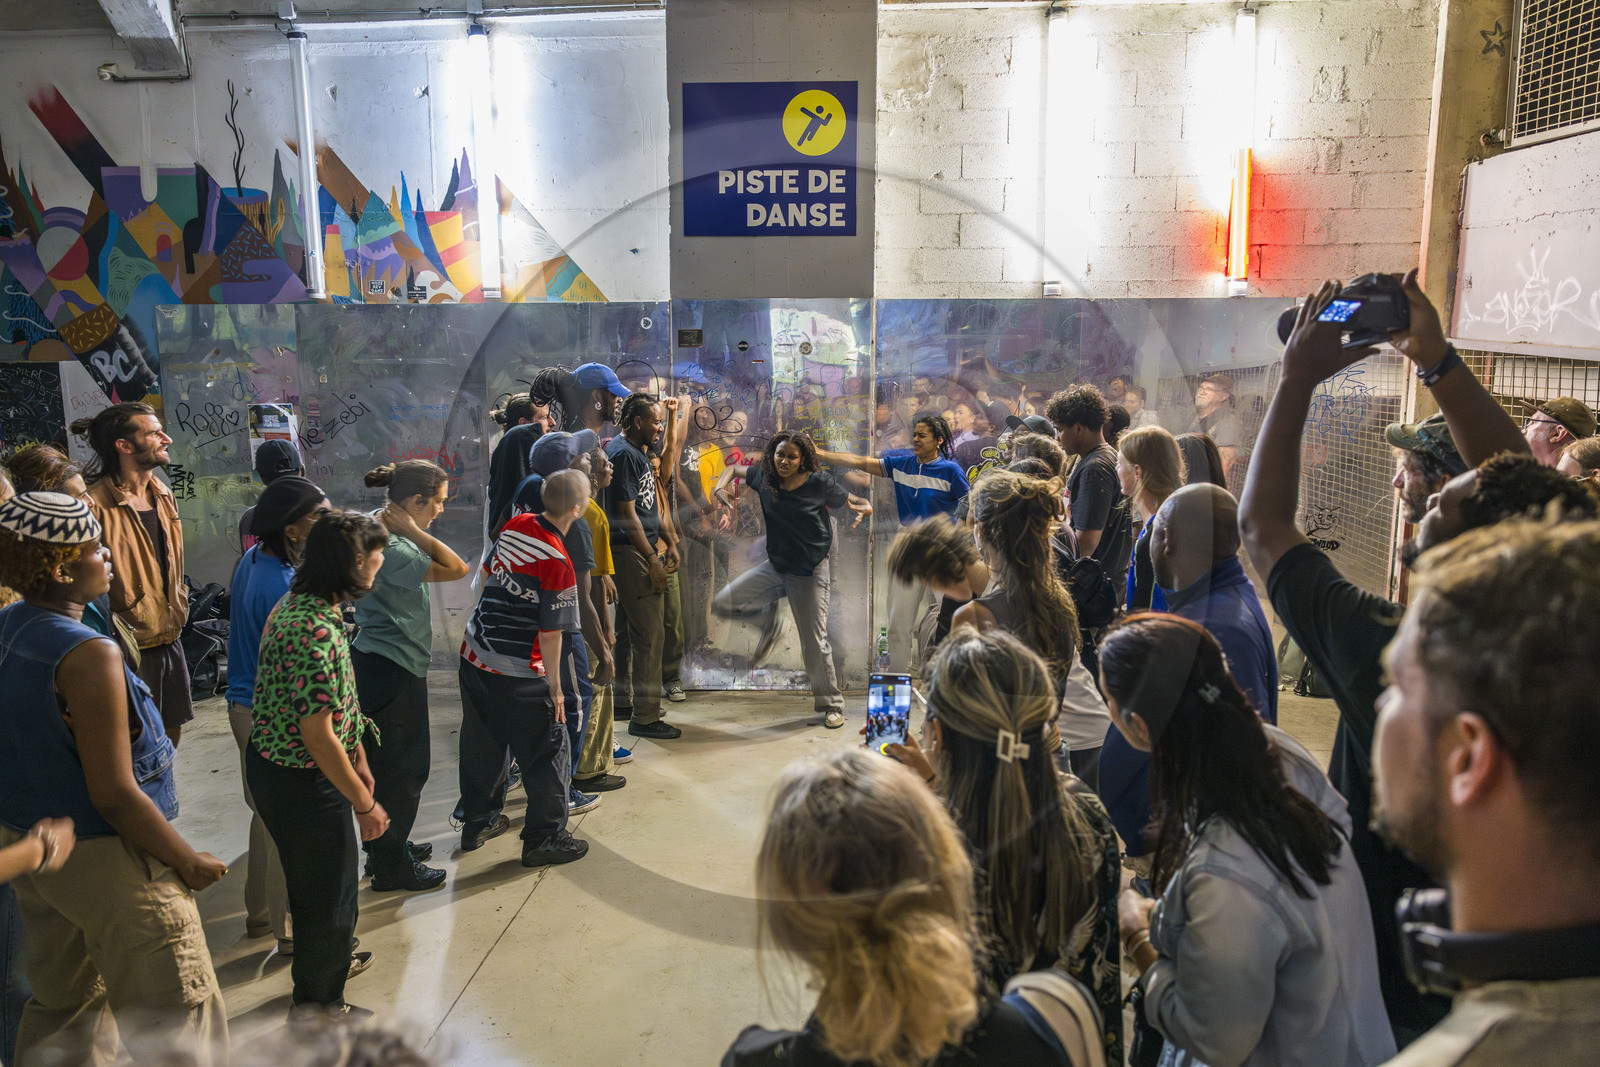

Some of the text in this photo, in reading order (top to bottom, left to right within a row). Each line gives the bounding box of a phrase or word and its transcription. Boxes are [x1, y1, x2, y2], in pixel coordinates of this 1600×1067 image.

[718, 169, 846, 194] PISTE DE
[746, 203, 846, 227] DANSE
